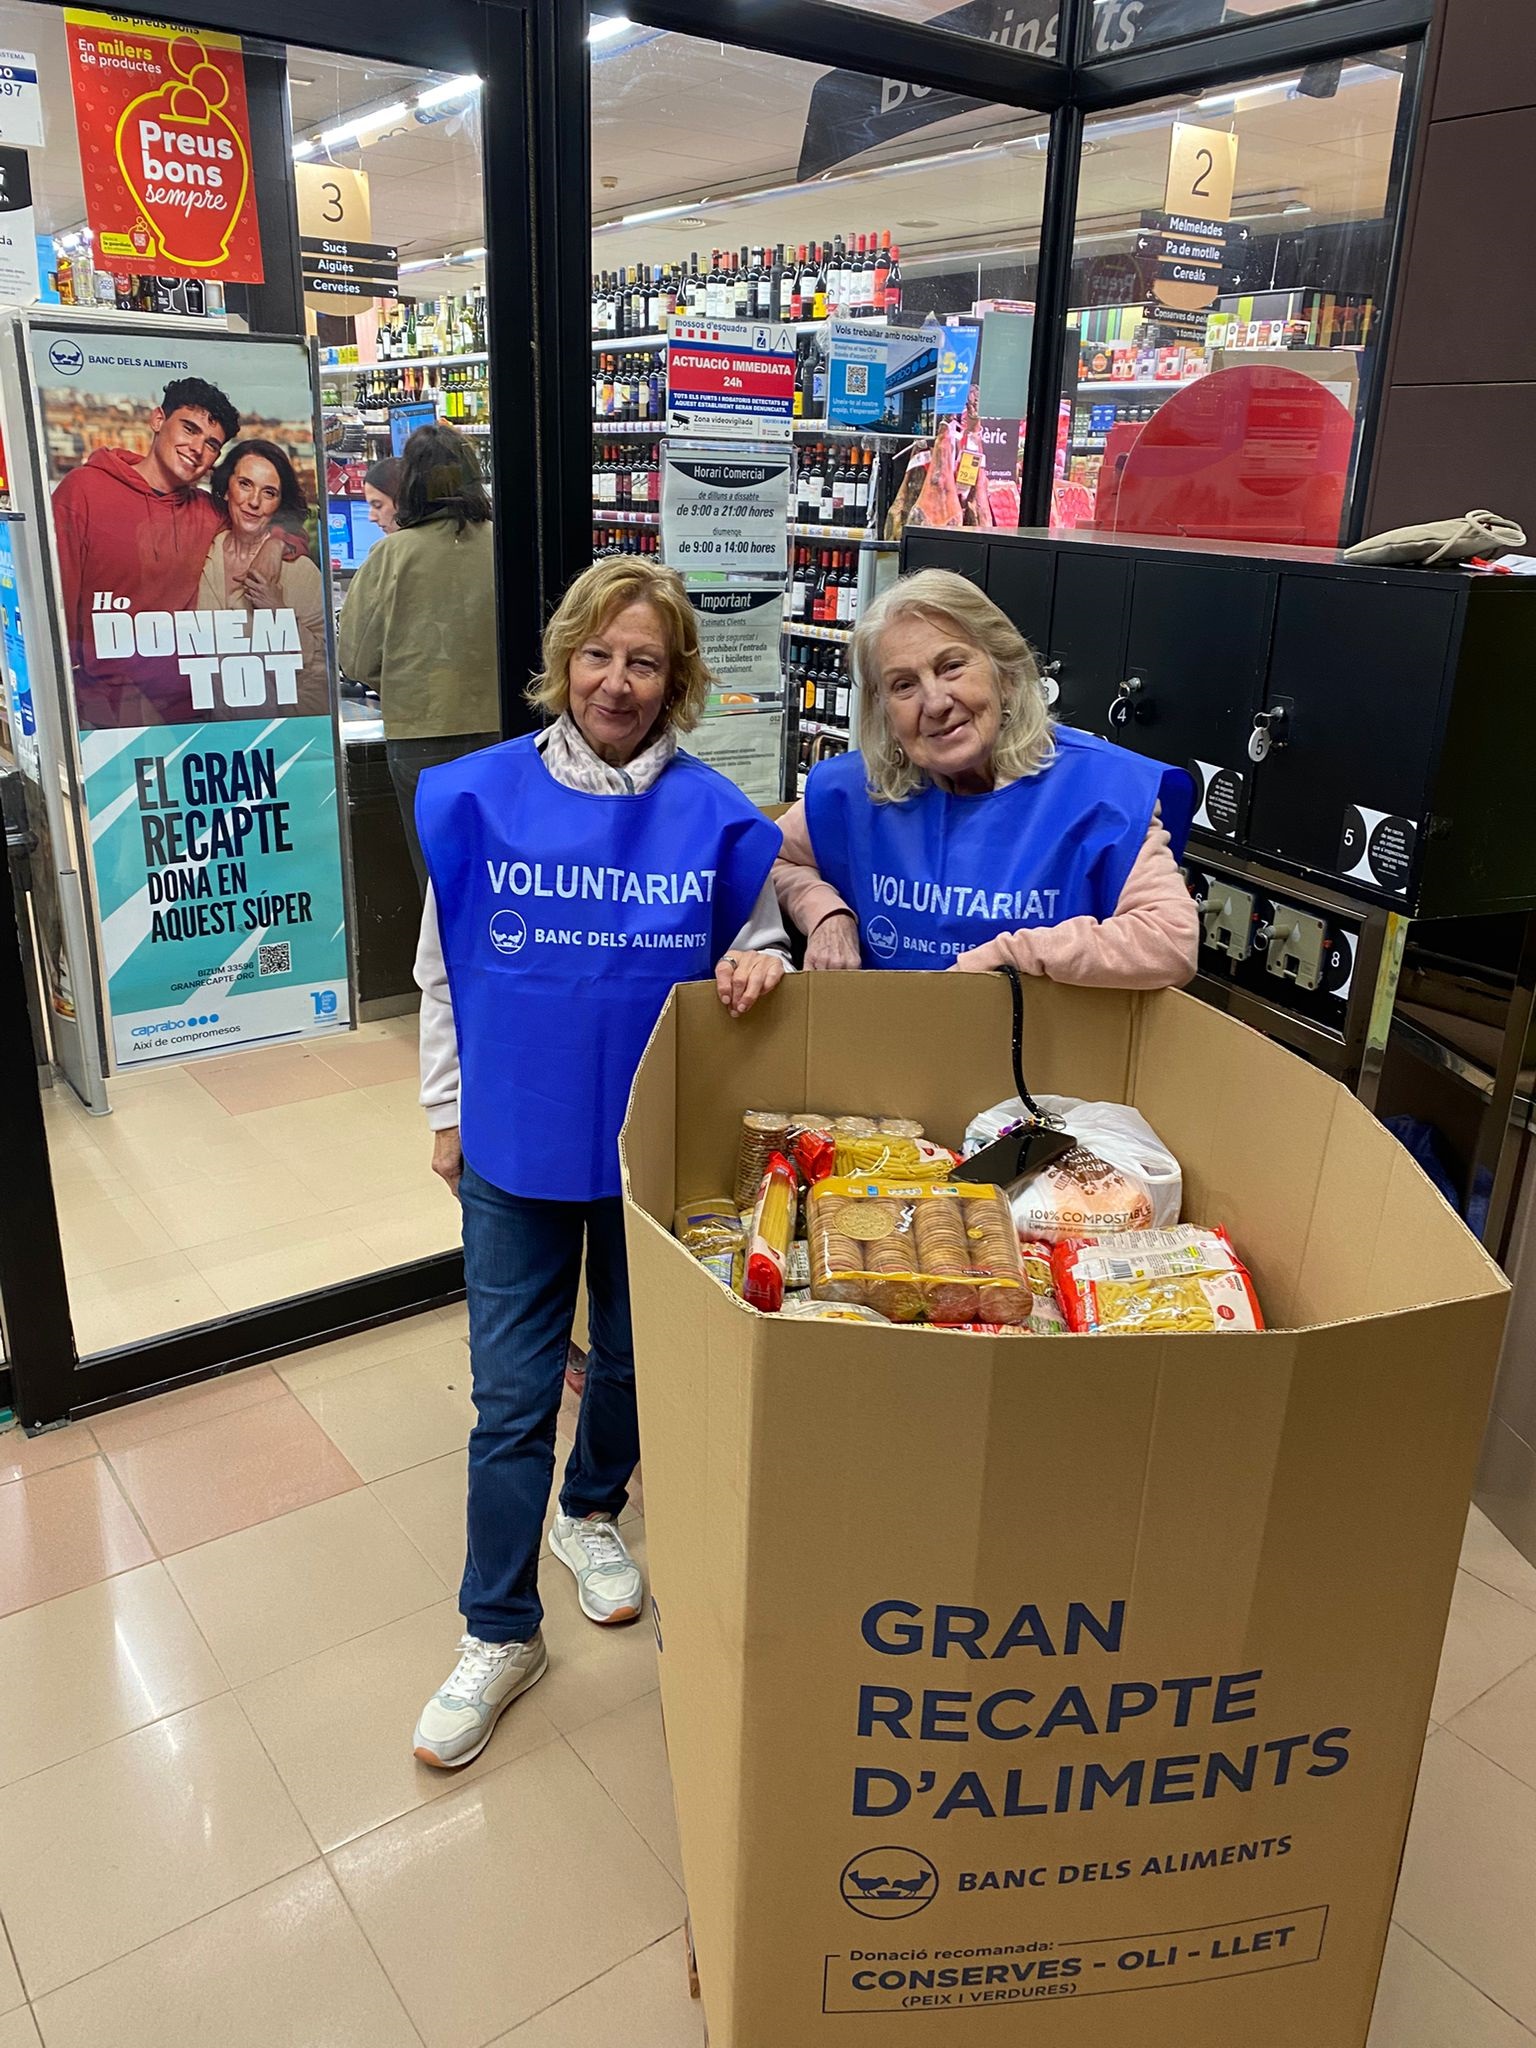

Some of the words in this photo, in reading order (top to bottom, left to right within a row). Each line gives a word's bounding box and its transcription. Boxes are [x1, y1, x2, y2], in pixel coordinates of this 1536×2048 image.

[78, 39, 95, 52] En
[98, 40, 152, 61] milers
[80, 52, 96, 65] de
[100, 56, 162, 74] productes
[138, 119, 234, 161] Preus
[141, 150, 223, 188] bons
[1191, 148, 1213, 197] 2
[145, 183, 228, 218] sempre
[321, 182, 344, 222] 3
[1169, 217, 1223, 237] Melmelades
[322, 241, 348, 255] Sucs
[1165, 240, 1177, 254] Pa
[1178, 243, 1191, 255] de
[317, 258, 354, 273] Aigües
[1173, 265, 1206, 281] Cereals
[313, 278, 361, 294] Cerveses
[1154, 307, 1186, 321] Conserves
[1187, 311, 1195, 321] de
[675, 319, 705, 329] mossos
[707, 322, 748, 333] d'esquadra
[835, 325, 852, 336] Vols
[853, 326, 884, 338] treballar
[884, 329, 901, 340] amb
[901, 332, 937, 344] nosaltres?
[88, 355, 115, 365] BANC
[117, 357, 141, 366] DELS
[143, 359, 189, 369] ALIMENTS
[672, 355, 730, 371] ACTUACIÓ
[732, 360, 792, 376] IMMEDIATA
[723, 376, 743, 388] 24h
[673, 392, 688, 400] TOTS
[688, 393, 699, 401] ELS
[700, 394, 718, 402] FURTS
[721, 395, 751, 404] ROBATORIS
[751, 397, 781, 406] DETECTATS
[674, 400, 697, 408] AQUEST
[697, 401, 735, 410] ESTABLIMENT
[694, 414, 711, 423] Zona
[711, 416, 753, 427] videovigilada
[694, 465, 721, 478] Horari
[723, 466, 765, 480] Comercial
[698, 491, 707, 500] de
[707, 491, 728, 501] dilluns
[734, 492, 760, 501] dissabte
[677, 504, 689, 516] de
[691, 504, 712, 517] 9:00
[713, 507, 719, 517] a
[721, 505, 747, 517] 21:00
[748, 505, 775, 518] hores
[712, 527, 742, 537] diumenge
[679, 541, 691, 553] de
[693, 541, 713, 553] 9:00
[715, 544, 721, 553] a
[724, 541, 749, 553] 14:00
[750, 541, 776, 553] hores
[91, 591, 131, 611] Ho
[700, 593, 752, 611] Important
[701, 618, 726, 627] Estimats
[726, 617, 746, 626] Clients
[91, 607, 303, 660] DONEM
[717, 633, 725, 642] de
[706, 643, 738, 655] prohibeix
[739, 641, 768, 652] l'entrada
[753, 654, 762, 662] en
[178, 653, 304, 710] TOT
[1117, 706, 1127, 722] 4
[1255, 738, 1264, 756] 5
[134, 755, 180, 812] EL
[182, 748, 278, 807] GRAN
[141, 802, 294, 867] RECAPTE
[1343, 827, 1355, 846] 5
[147, 866, 213, 905] DONA
[218, 862, 248, 897] EN
[486, 860, 717, 905] VOLUNTARIAT
[872, 873, 1060, 920] VOLUNTARIAT
[151, 901, 240, 944] AQUEST
[242, 890, 313, 931] SÚPER
[534, 928, 582, 945] BANC
[587, 931, 627, 947] DELS
[632, 932, 707, 949] ALIMENTS
[903, 936, 936, 954] BANC
[1330, 951, 1341, 968] 8
[197, 966, 226, 978] BIZUM
[227, 962, 254, 973] 33596
[170, 972, 255, 992] GRANRECAPTE.ORG
[131, 1019, 186, 1037] caprabo
[132, 1039, 153, 1051] Així
[154, 1037, 169, 1047] de
[170, 1025, 241, 1044] compromesos
[1062, 1204, 1152, 1224] COMPOSTABLE
[860, 1599, 1127, 1661] GRAN
[856, 1669, 1263, 1742] RECAPTE
[851, 1726, 1352, 1819] D'ALIMENTS
[957, 1867, 1047, 1893] BANC
[1057, 1859, 1132, 1885] DELS
[1140, 1834, 1293, 1877] ALIMENTS
[849, 1949, 928, 1962] Donació
[933, 1940, 1055, 1960] recomanada:
[851, 1956, 1083, 1992] CONSERVES
[1116, 1946, 1178, 1972] OLI
[1210, 1925, 1297, 1961] LLET
[901, 1992, 953, 2009] (PEIX
[958, 1993, 964, 2004] I
[969, 1982, 1078, 2003] VERDURES)
